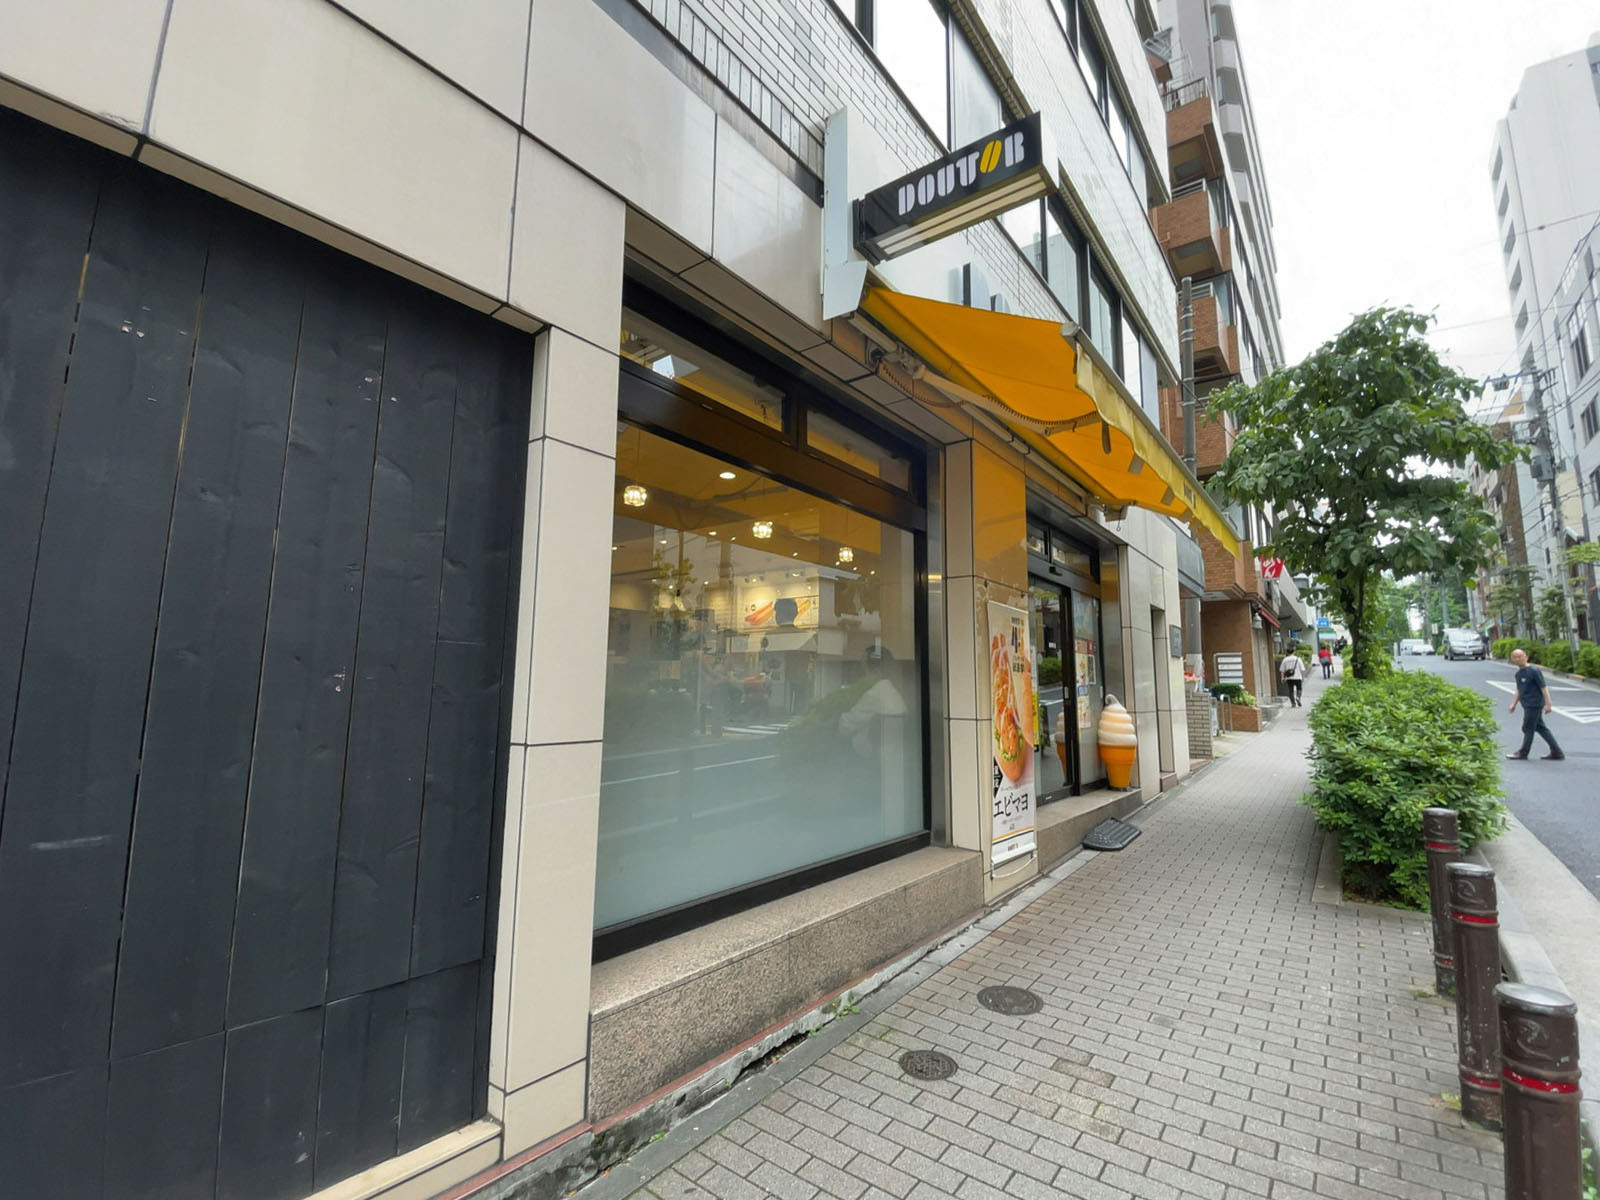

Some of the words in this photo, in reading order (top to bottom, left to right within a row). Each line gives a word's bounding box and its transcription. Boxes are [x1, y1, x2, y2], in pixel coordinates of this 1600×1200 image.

[898, 132, 1025, 215] DOUTOR
[993, 791, 1029, 818] エビマヨ
